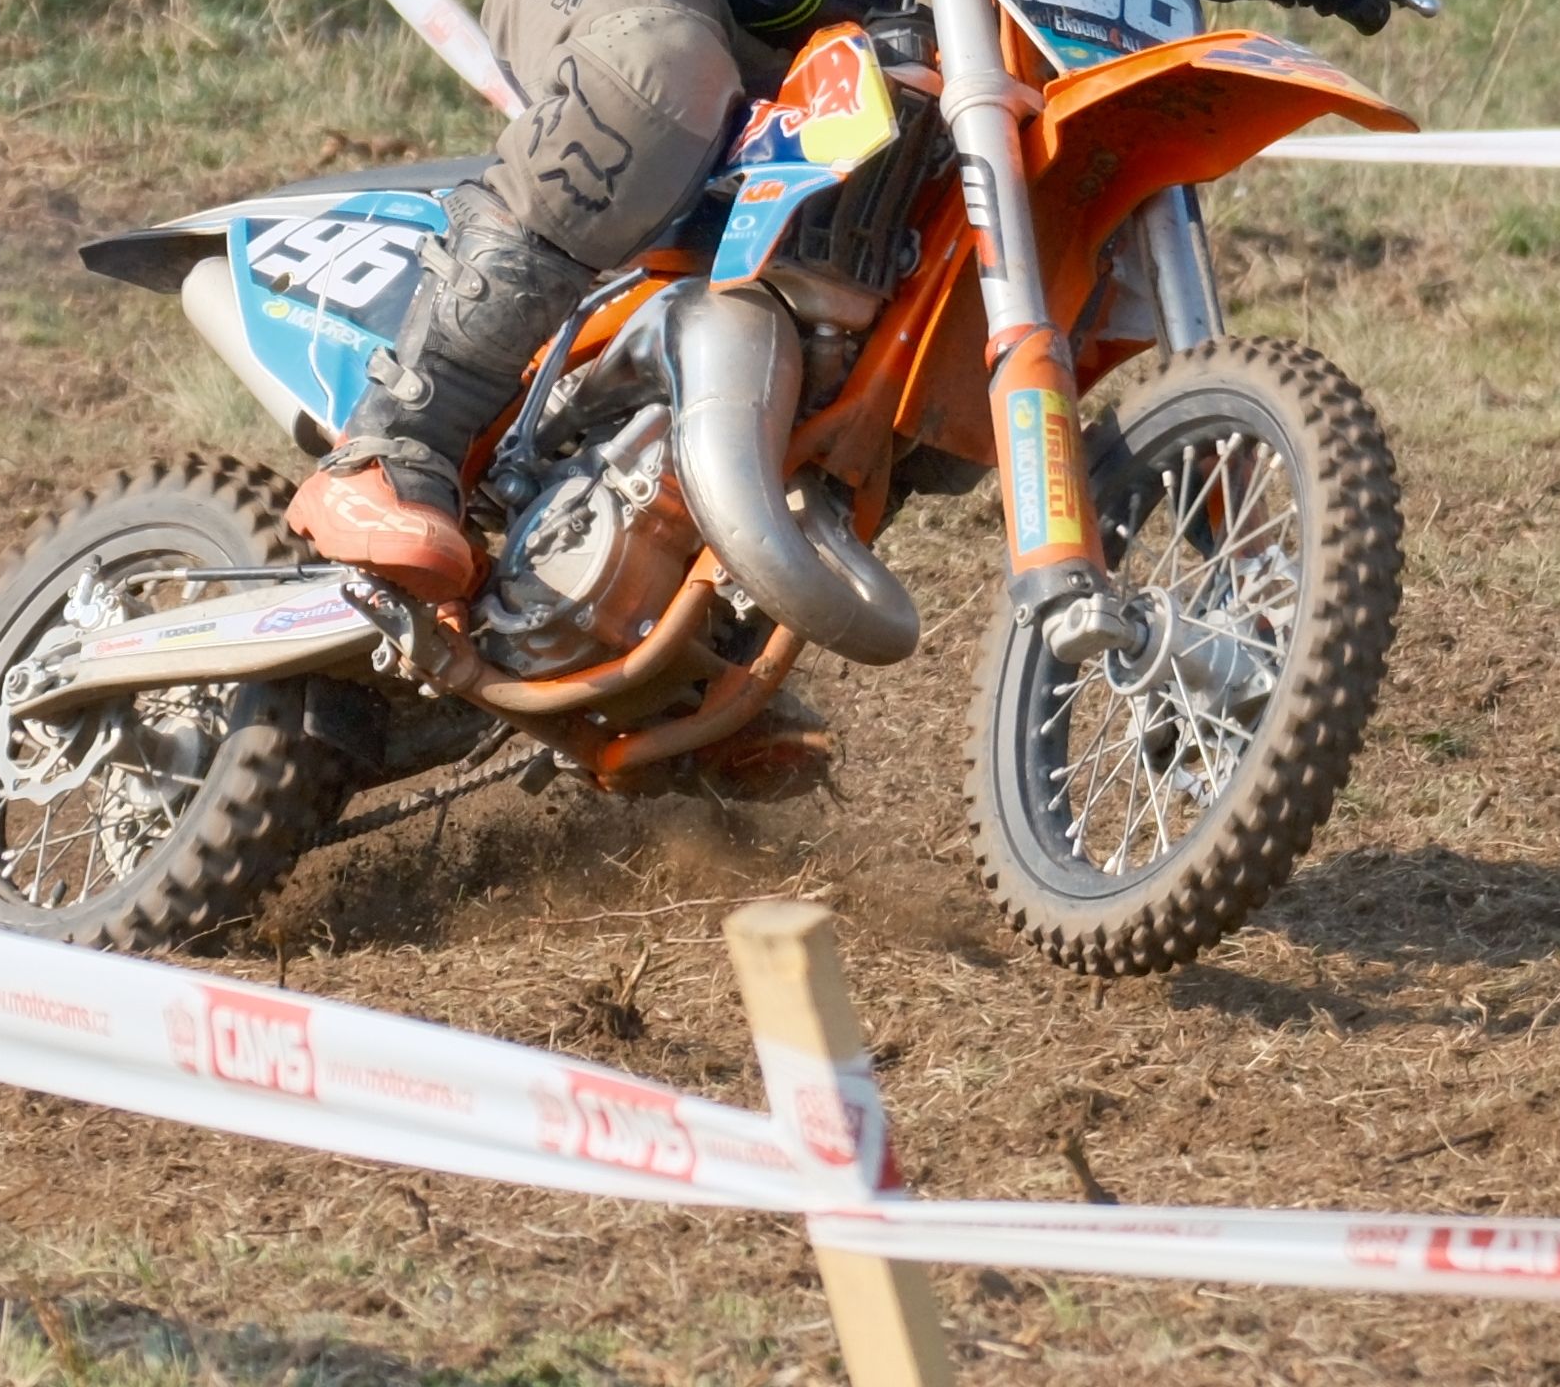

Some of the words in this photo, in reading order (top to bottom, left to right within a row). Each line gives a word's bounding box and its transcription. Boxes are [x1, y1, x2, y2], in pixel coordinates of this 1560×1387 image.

[1054, 13, 1109, 42] ENDURO
[246, 219, 427, 308] 196
[1045, 412, 1077, 519] PIRELLI
[209, 1003, 316, 1099] CAMS
